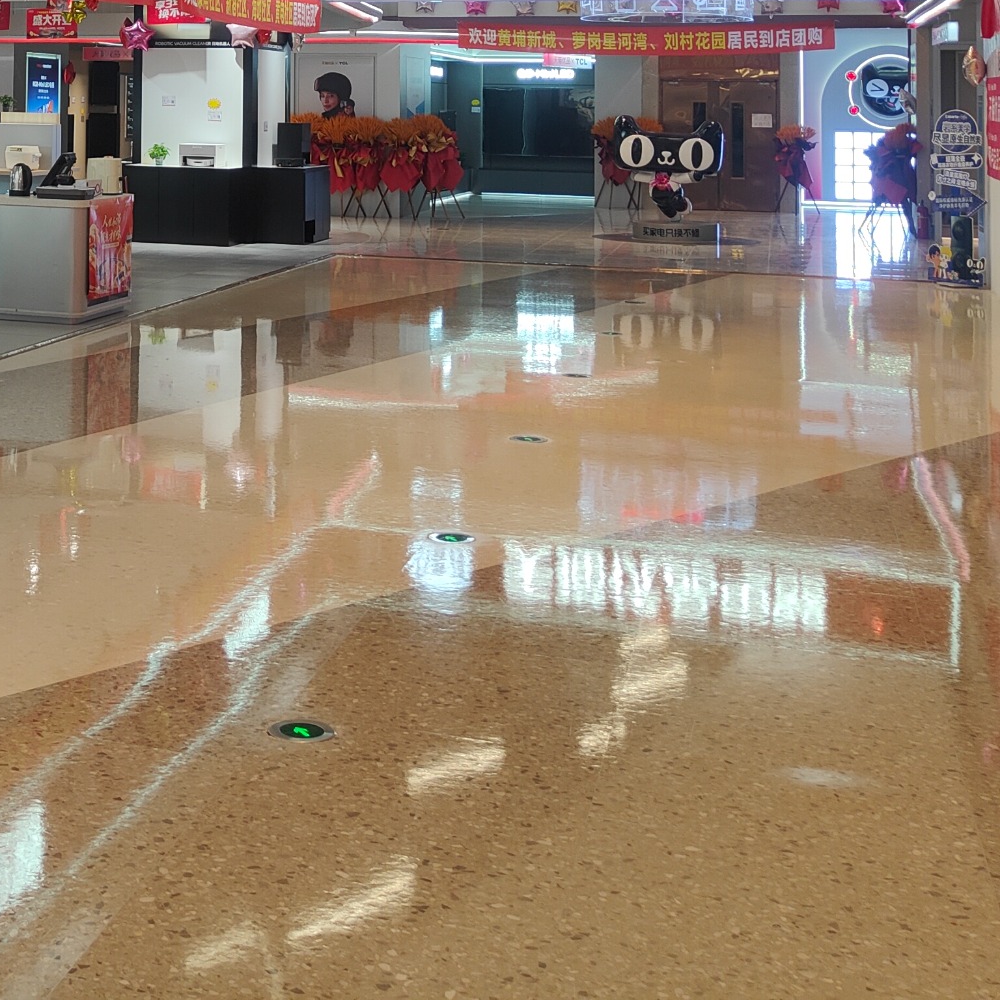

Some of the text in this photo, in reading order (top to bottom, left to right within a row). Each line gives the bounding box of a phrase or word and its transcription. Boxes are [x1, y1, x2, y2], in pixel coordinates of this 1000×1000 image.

[468, 27, 823, 51] 欢迎黄埔新城、萝岗星河湾、刘村花园居民到店团购
[575, 58, 588, 66] TCL
[642, 226, 700, 238] 买家电只换不修
